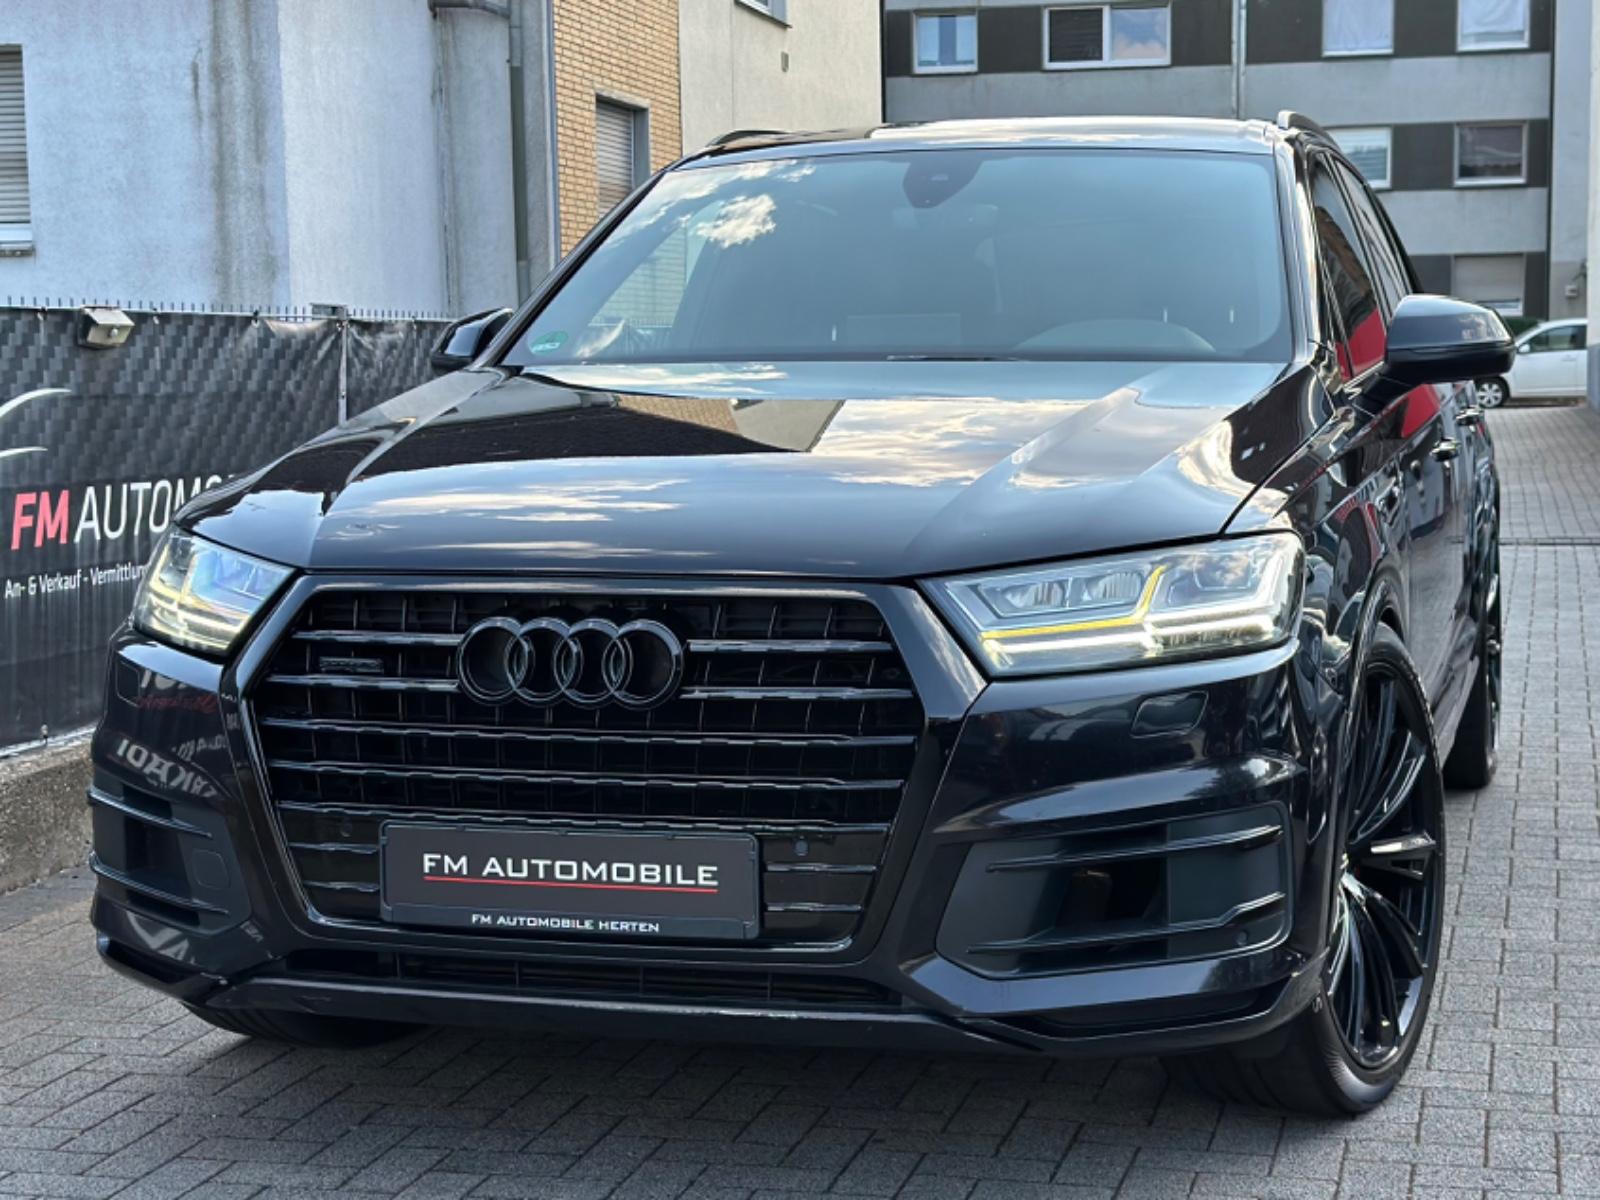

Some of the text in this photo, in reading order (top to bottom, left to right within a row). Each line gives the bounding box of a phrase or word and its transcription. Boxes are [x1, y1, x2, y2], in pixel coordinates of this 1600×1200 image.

[11, 474, 235, 550] FM AUTOM
[39, 568, 82, 593] Verkauf
[422, 852, 719, 886] FM AUTOMOBILE
[471, 913, 659, 933] FM AUTOMOBILE HERTEN
